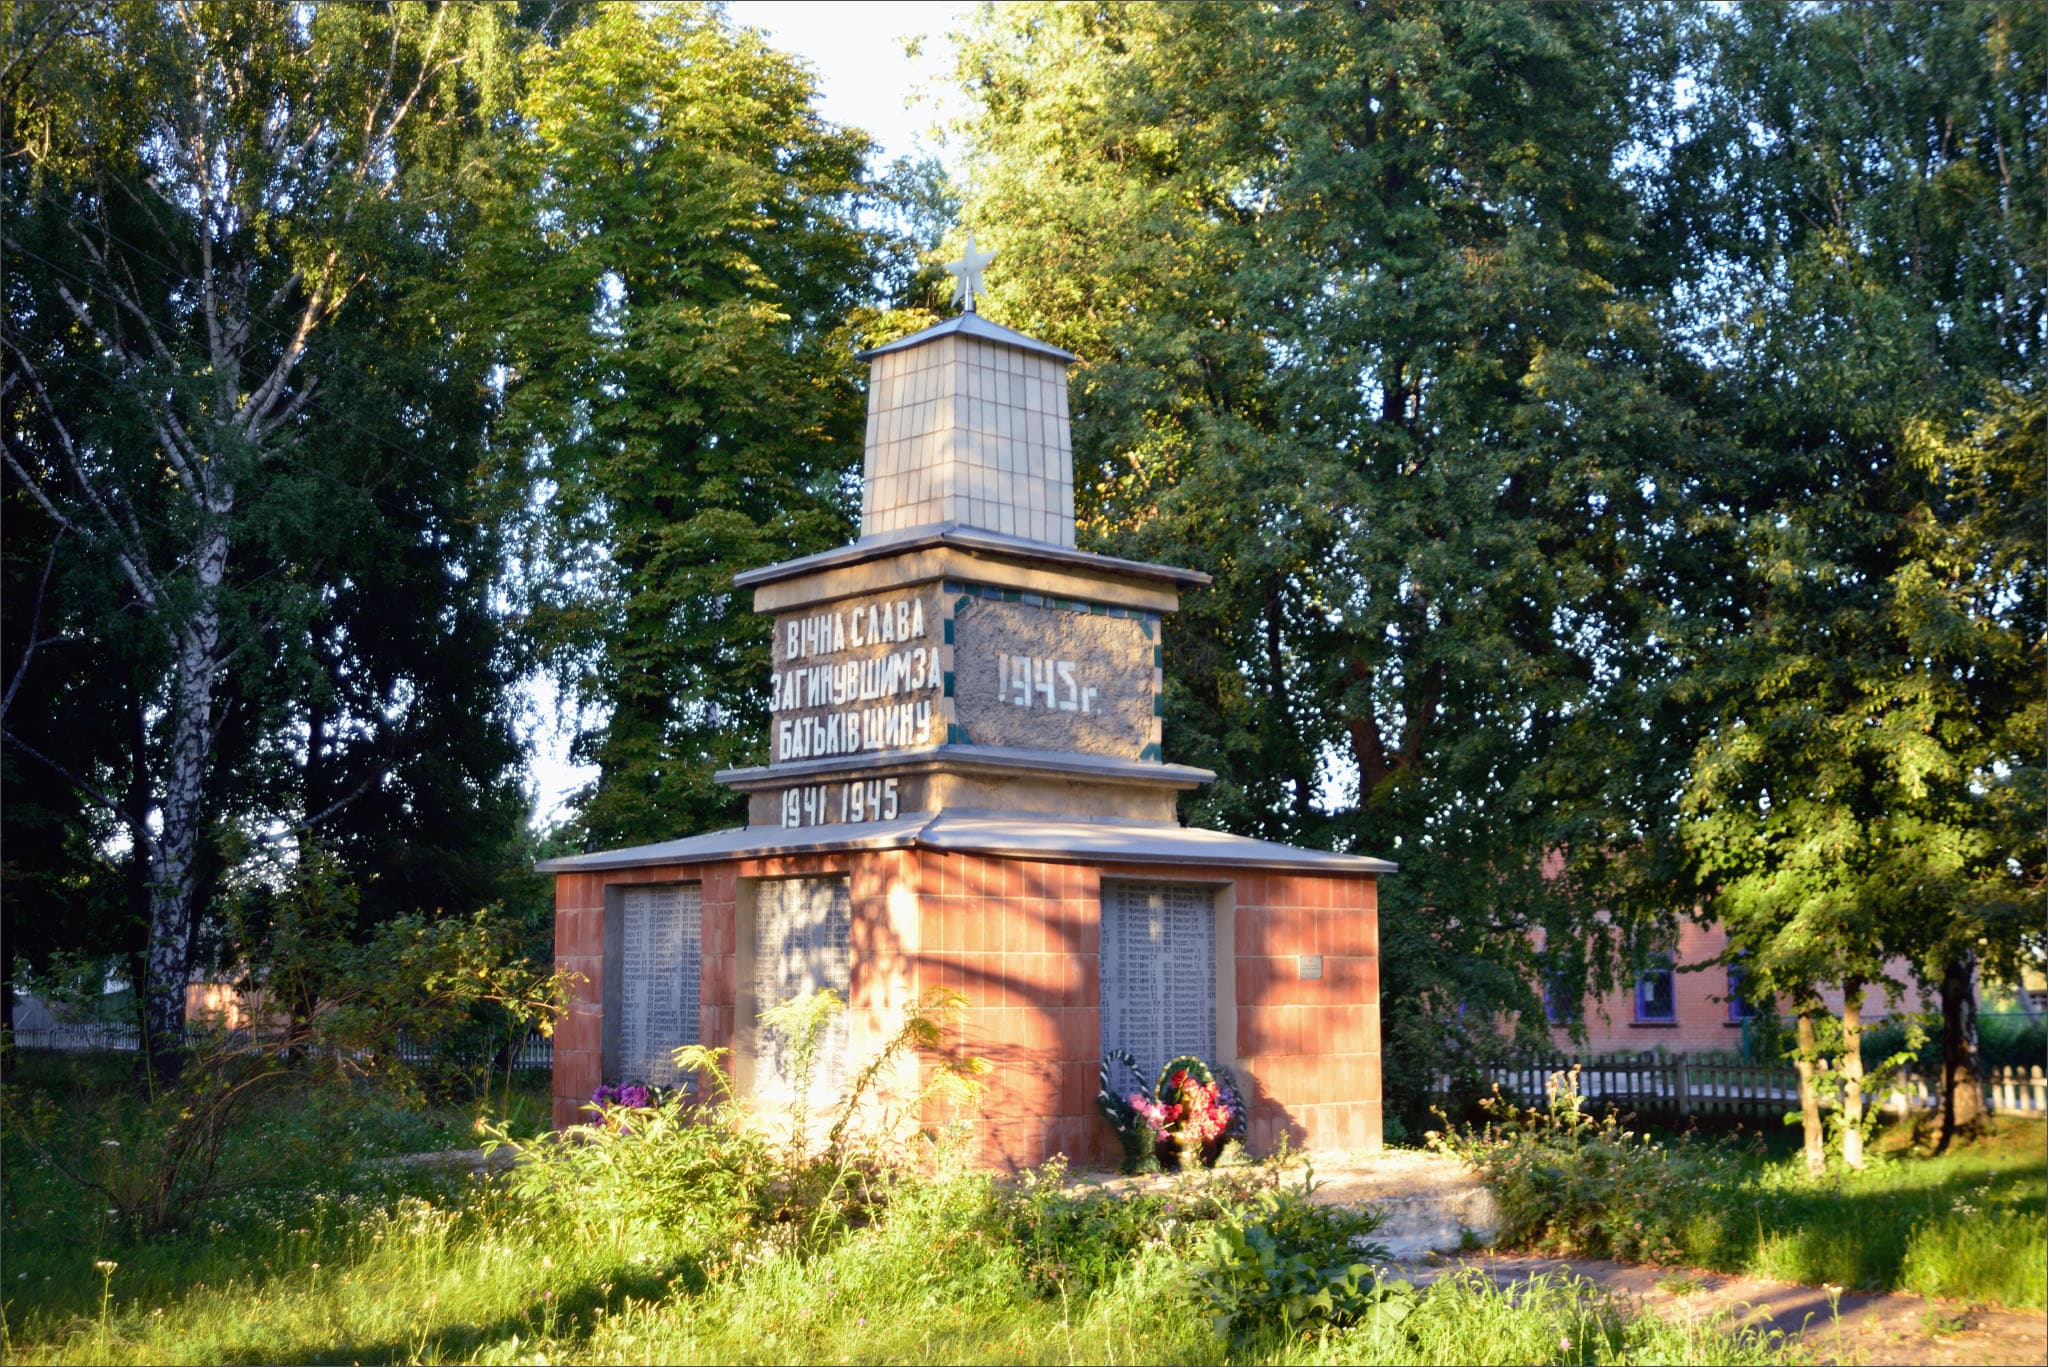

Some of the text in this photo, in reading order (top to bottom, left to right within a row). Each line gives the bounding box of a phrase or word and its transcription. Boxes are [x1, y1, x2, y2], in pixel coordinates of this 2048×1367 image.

[787, 598, 925, 660] ВІЧНА СЛАВА
[769, 646, 942, 712] ЗАГИНУВШИМ ЗА
[779, 700, 931, 760] БАТЬКІВЩИНУ
[781, 777, 899, 829] 1941 1945
